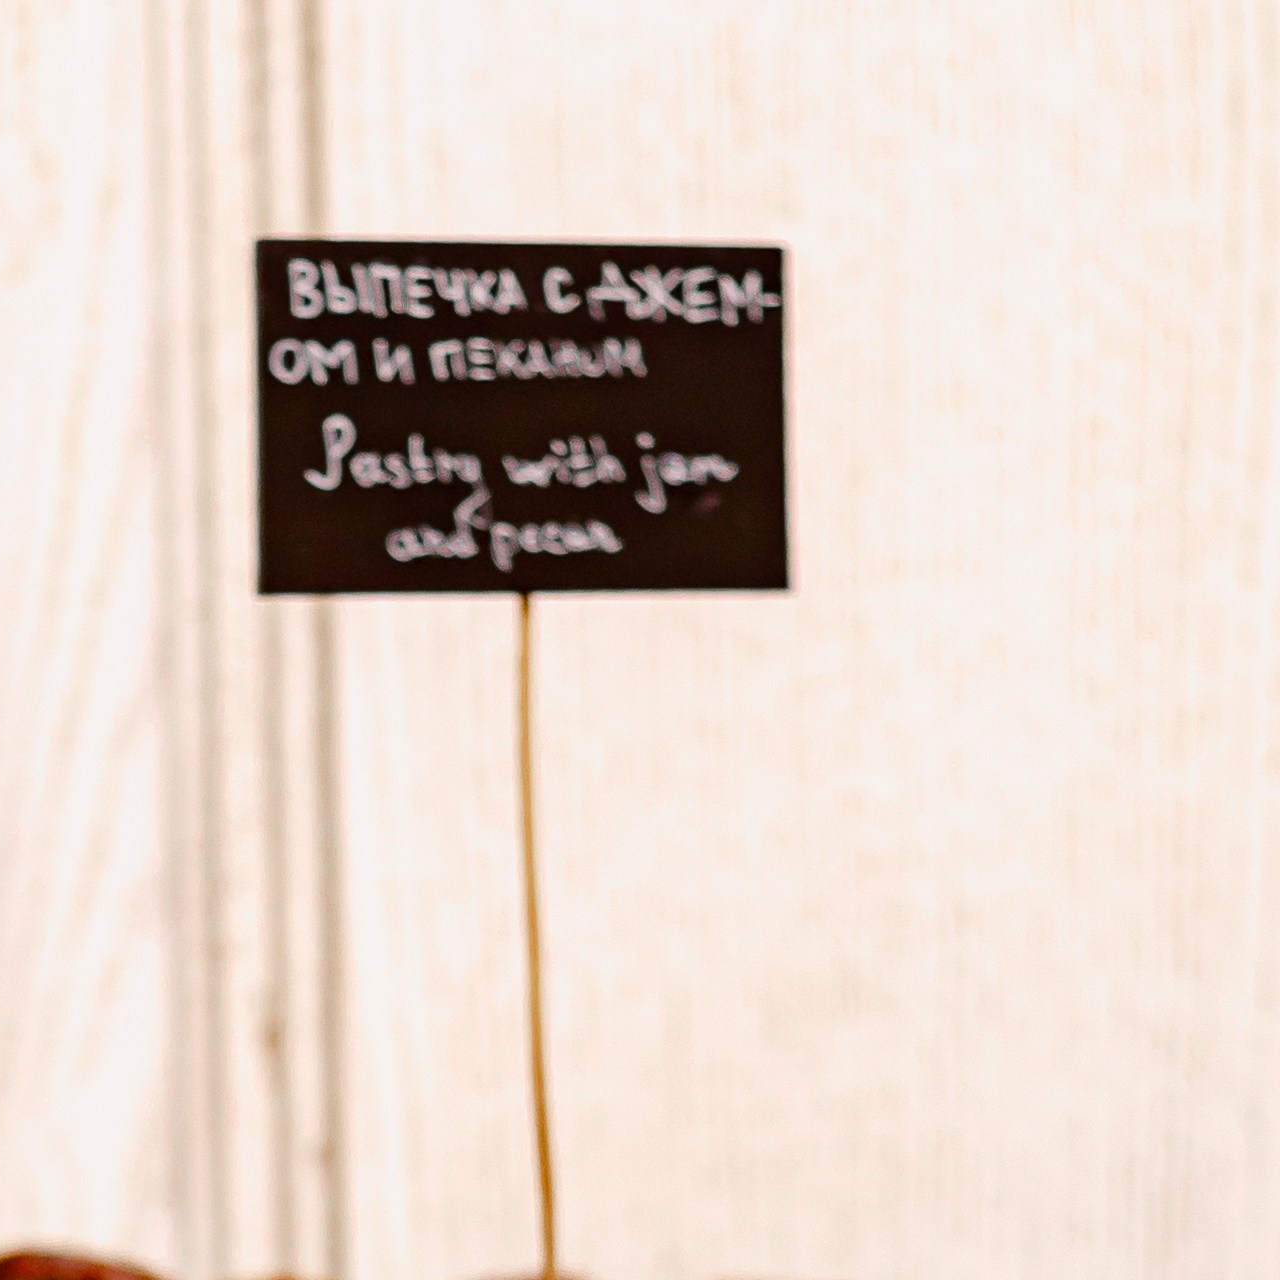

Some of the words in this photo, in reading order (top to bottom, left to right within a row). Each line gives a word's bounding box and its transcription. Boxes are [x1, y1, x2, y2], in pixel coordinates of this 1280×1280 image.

[287, 257, 527, 318] ВЫПЕЧКА
[268, 338, 359, 385] ОМ
[372, 337, 415, 385] И
[501, 433, 626, 488] with
